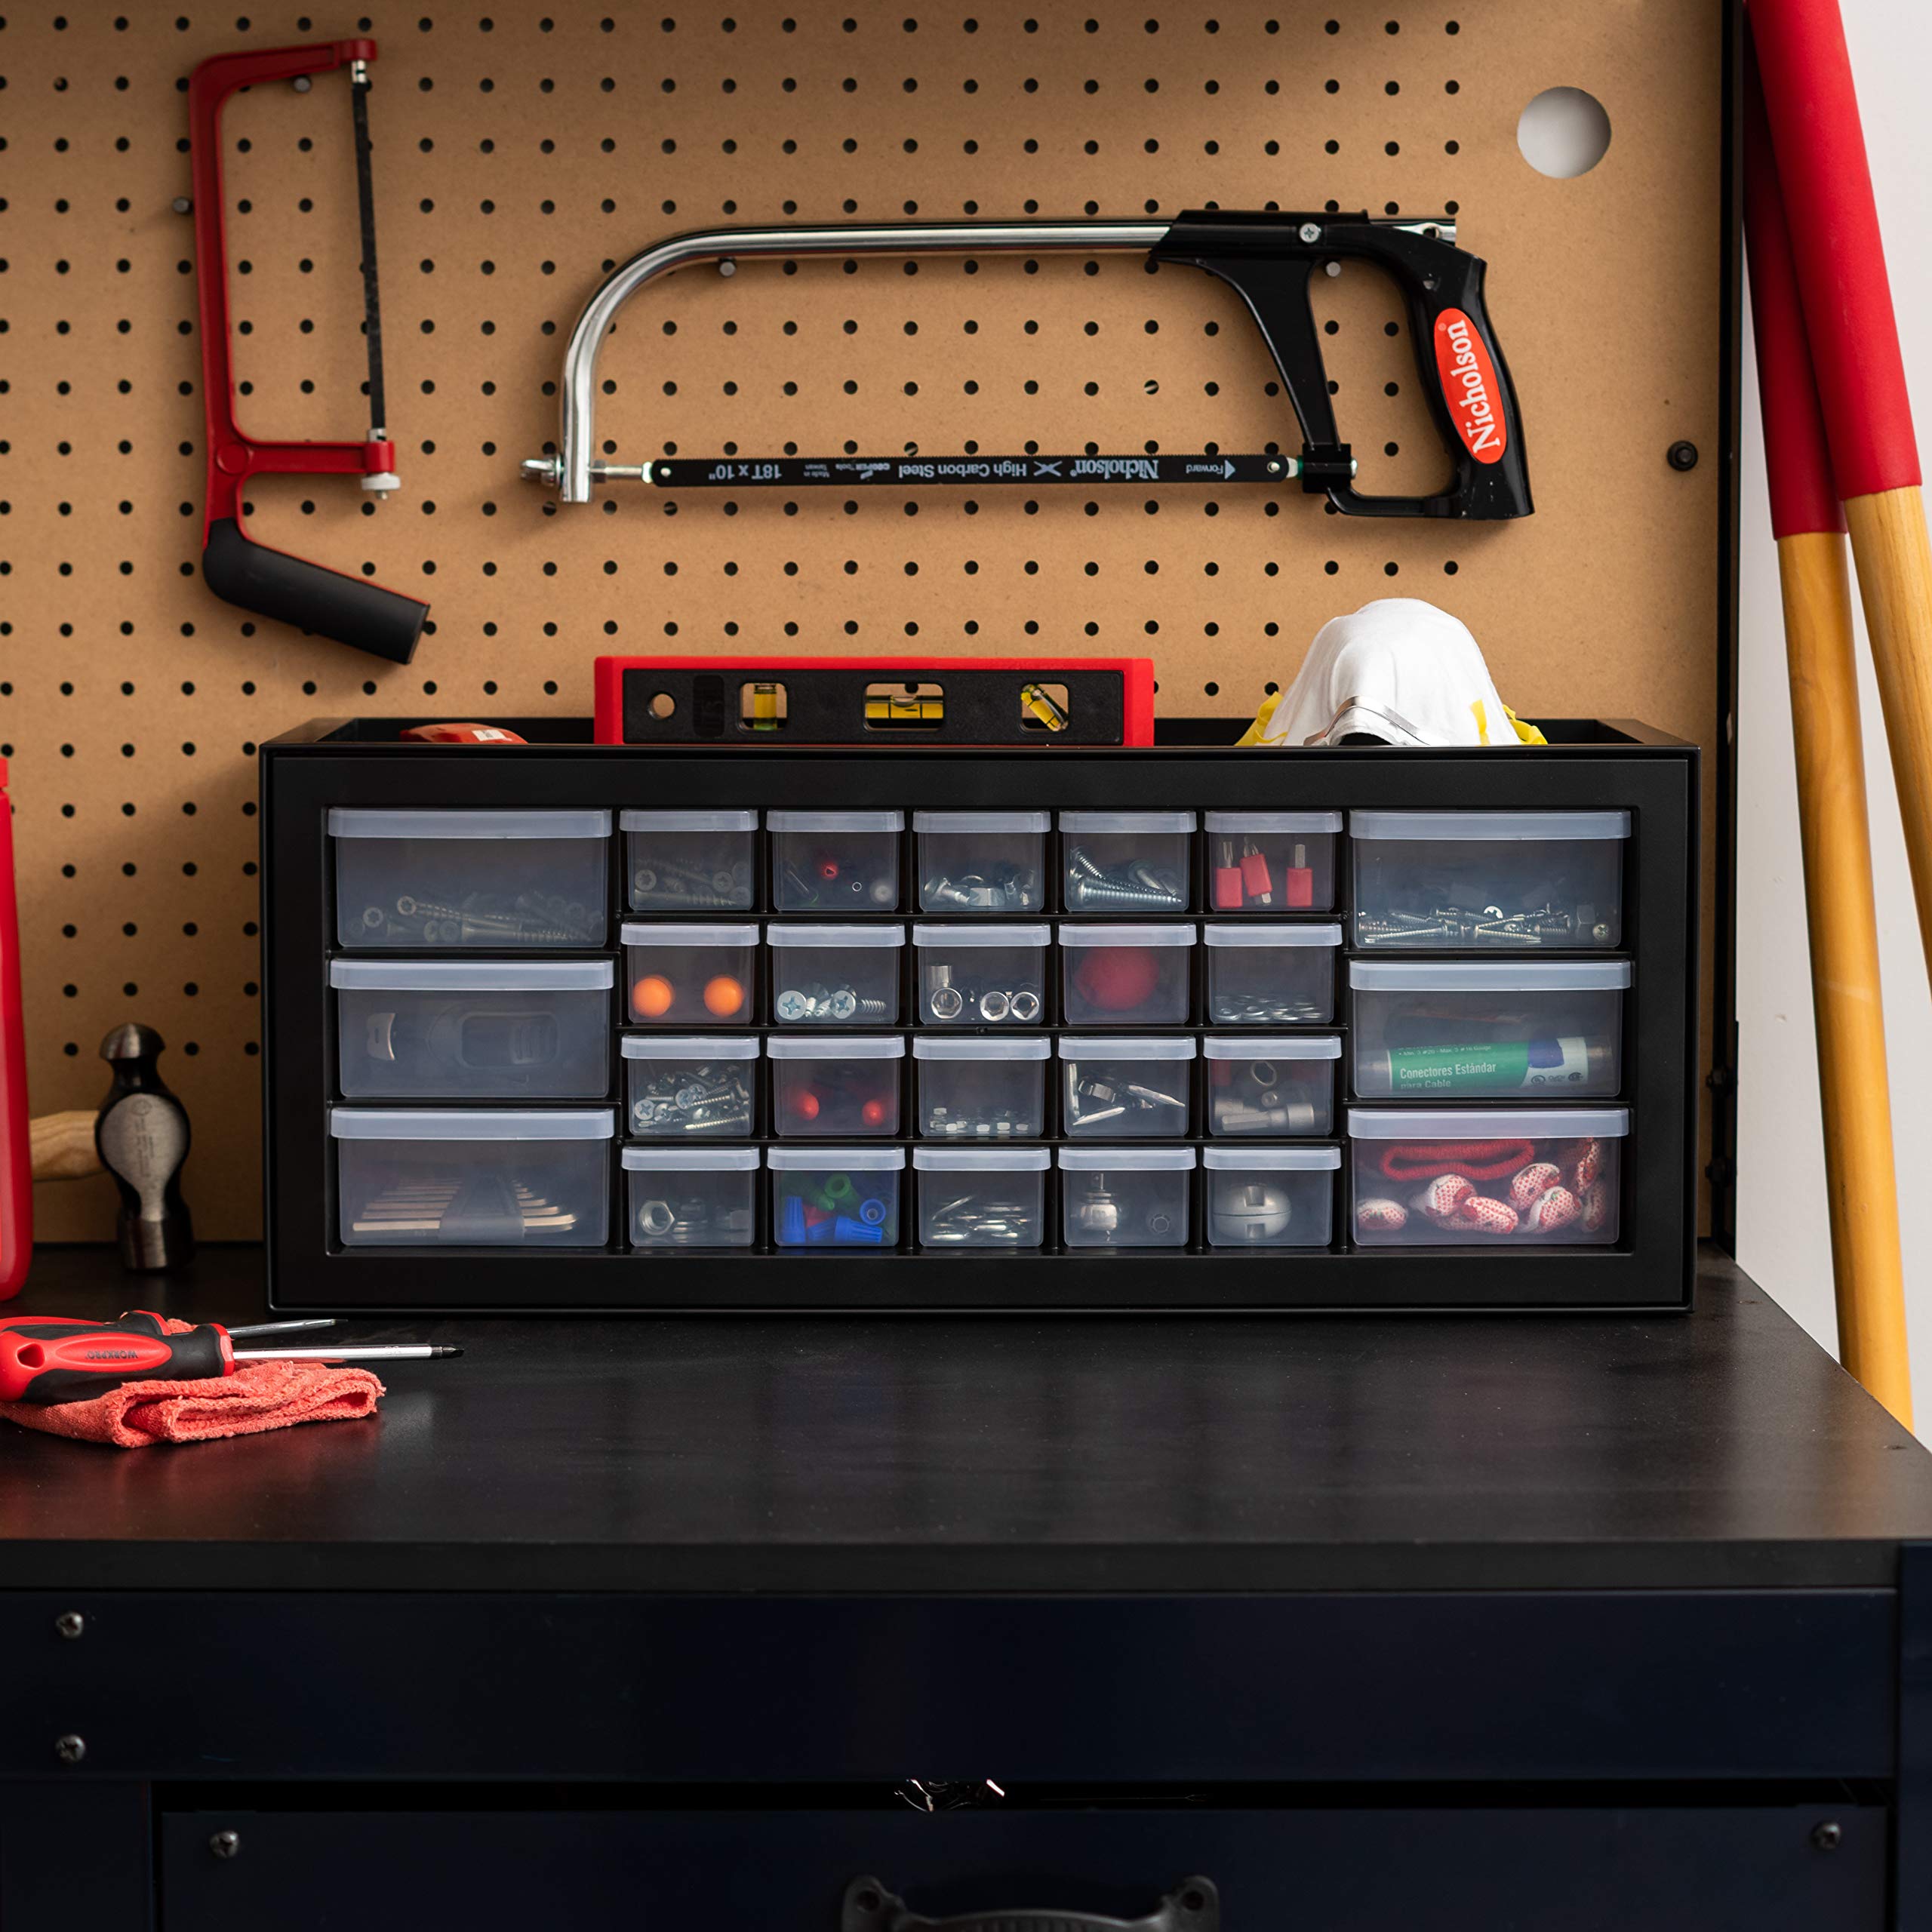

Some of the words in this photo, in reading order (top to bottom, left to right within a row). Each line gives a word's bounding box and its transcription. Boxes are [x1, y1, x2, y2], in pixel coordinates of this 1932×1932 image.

[1447, 319, 1501, 454] Nicholson
[738, 465, 749, 477] x
[752, 464, 782, 480] 18T
[899, 464, 934, 478] Steel
[938, 463, 990, 478] Carbon
[993, 461, 1026, 477] High
[1075, 459, 1159, 480] Nicholson
[1186, 463, 1224, 474] Forward
[1400, 1066, 1454, 1079] Conectores
[1455, 1062, 1497, 1075] Estándar
[1425, 1079, 1451, 1088] Cable
[86, 1349, 138, 1359] WORKPRO
